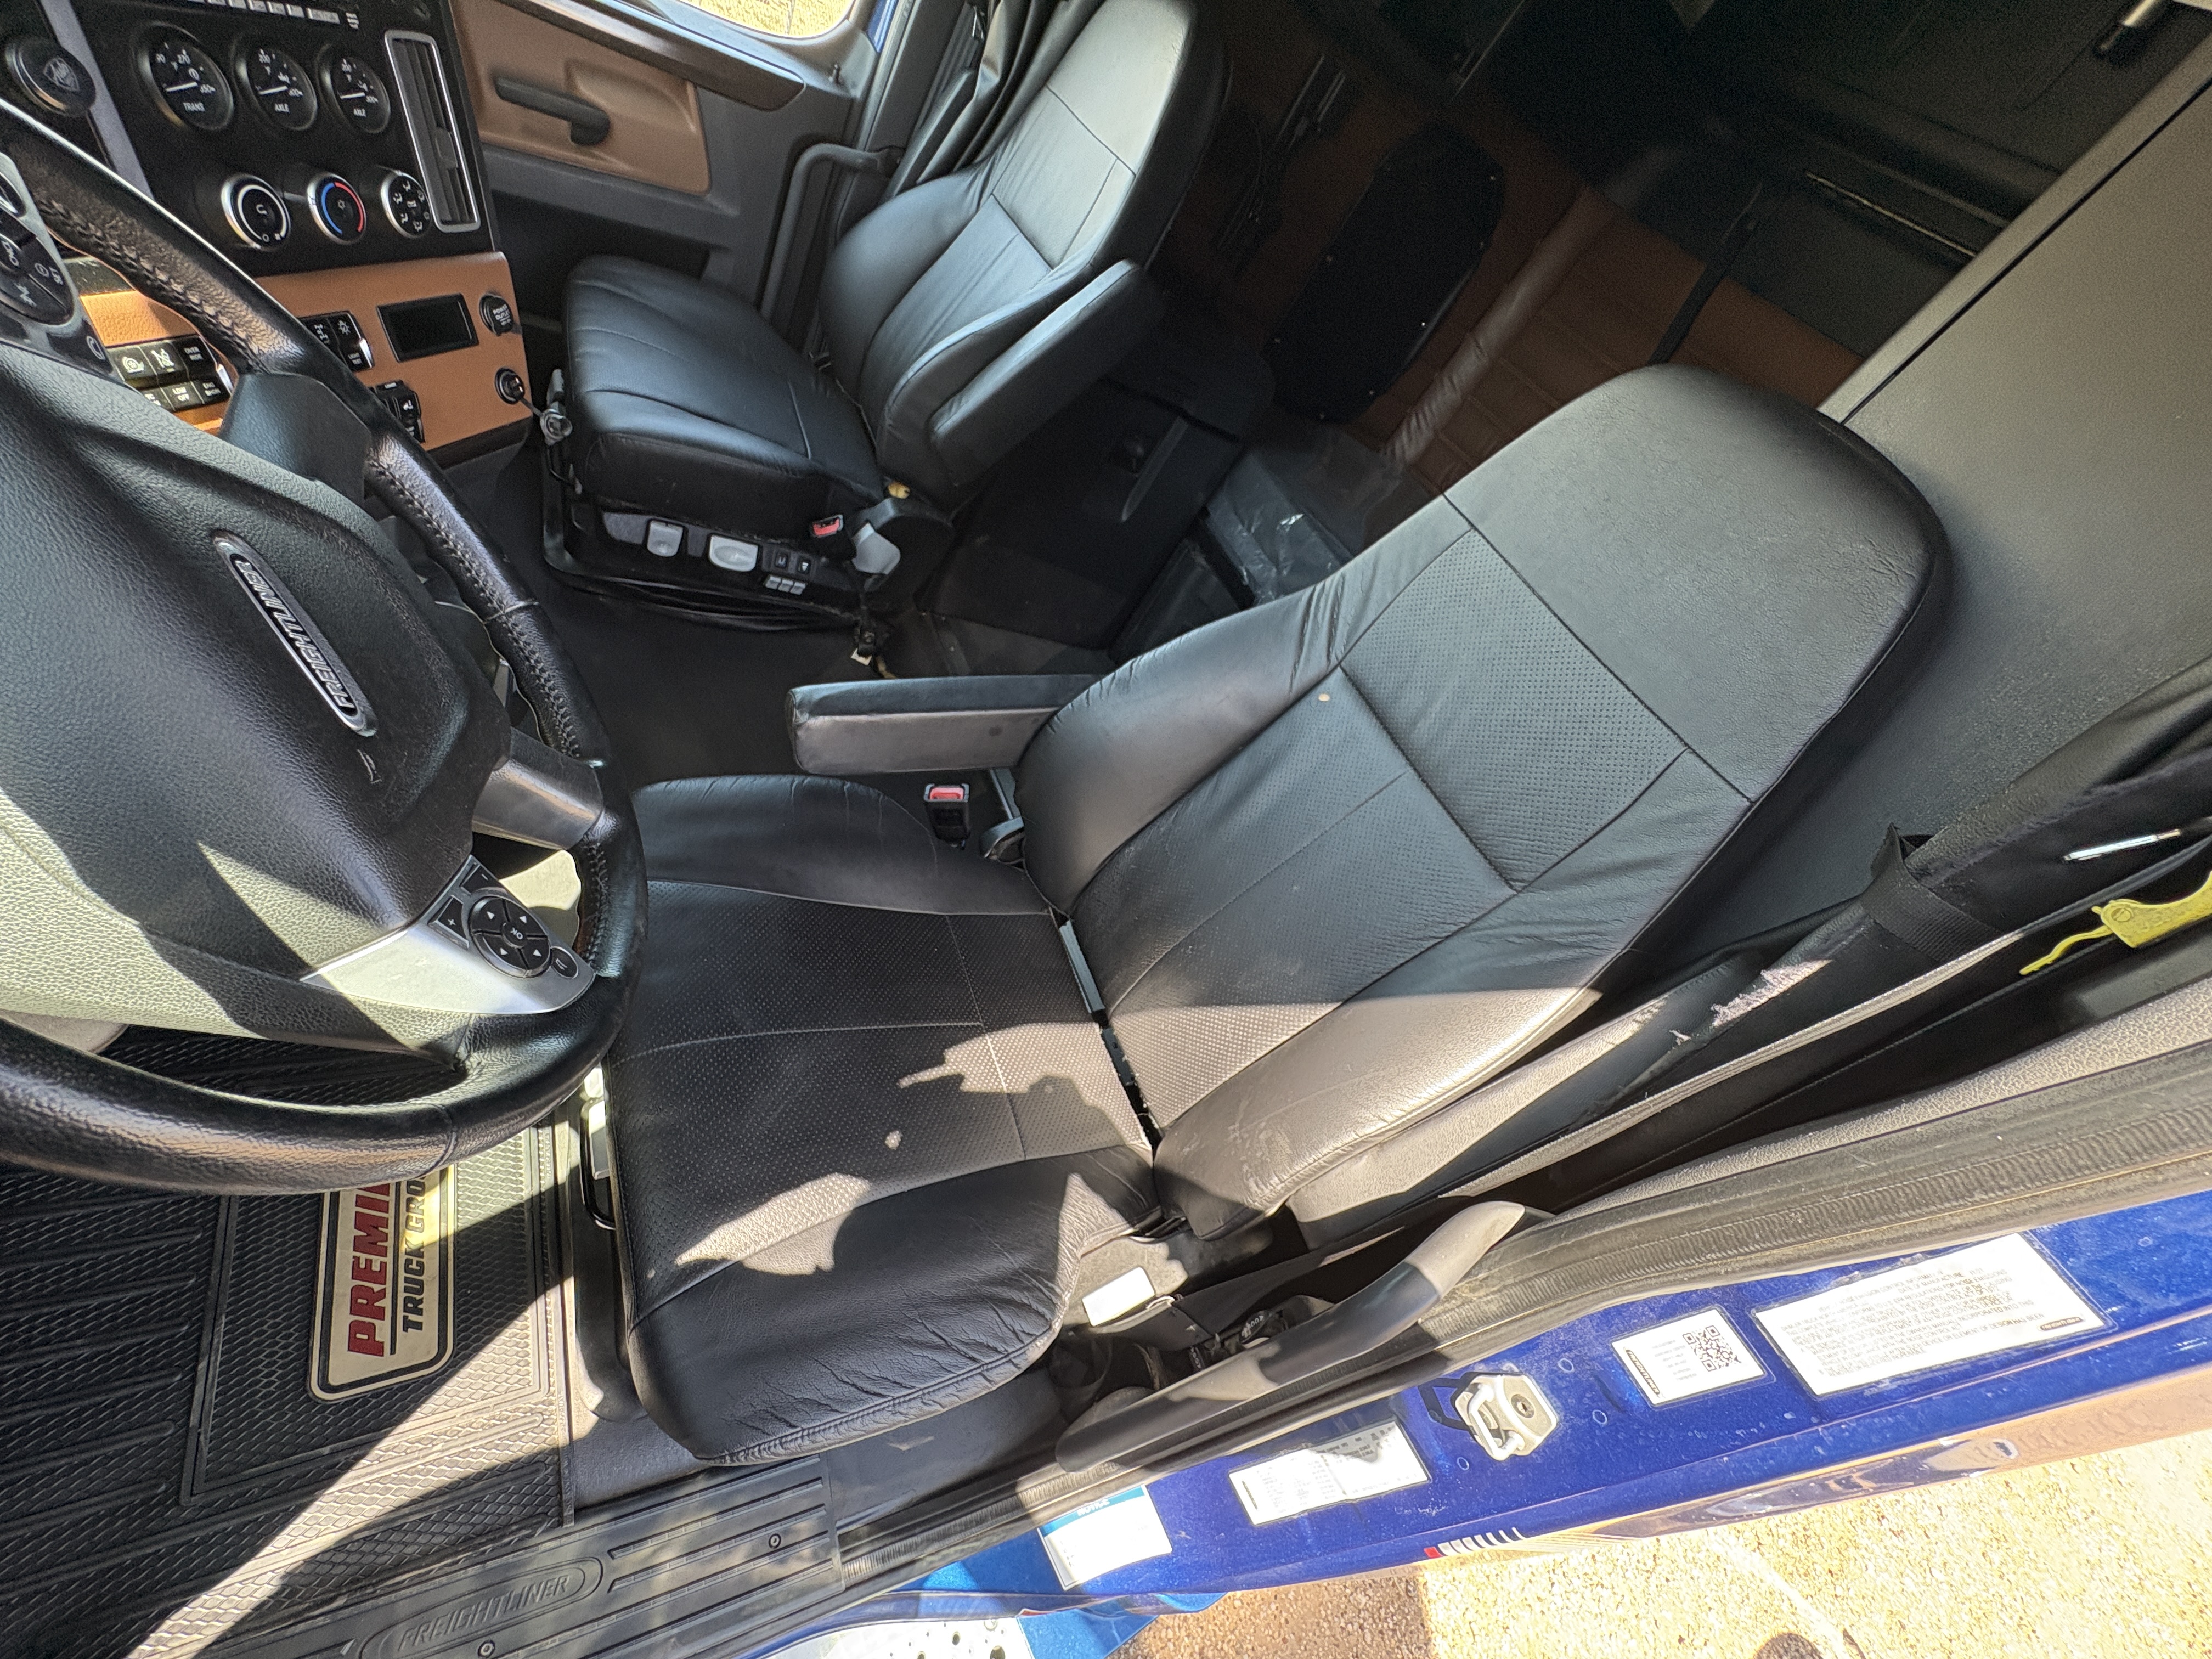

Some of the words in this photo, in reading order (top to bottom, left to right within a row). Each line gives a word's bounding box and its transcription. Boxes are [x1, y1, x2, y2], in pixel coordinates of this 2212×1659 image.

[183, 102, 205, 112] TRANS
[275, 103, 290, 114] AXLE
[354, 108, 366, 117] AXLE
[493, 303, 508, 315] POWER
[184, 346, 201, 354] OVER
[177, 393, 190, 402] OFF
[235, 560, 356, 709] FREIGHTLINER
[510, 927, 524, 940] OK
[405, 1177, 426, 1233] GRO
[348, 1182, 391, 1357] PREMI
[403, 1238, 425, 1333] TRUCK
[1904, 1286, 1943, 1299] REGULATIONS
[1973, 1269, 2007, 1282] EMISSIONS
[1921, 1272, 1964, 1286] MANUFACTURE
[1984, 1276, 2012, 1288] CAUSING
[1880, 1282, 1905, 1291] CONTROL
[1920, 1308, 1940, 1317] OTHER
[1940, 1304, 1957, 1312] THAN
[1969, 1293, 2001, 1305] PURPOSES
[1936, 1293, 1964, 1305] CONTROL
[1953, 1304, 1980, 1314] CONTROL
[1980, 1298, 2003, 1307] DEVICE
[1957, 1307, 2003, 1321] INCORPORATED
[1888, 1346, 1906, 1355] AFTER
[1921, 1337, 1943, 1346] DEVICE
[1952, 1327, 1979, 1339] ELEMENT
[1989, 1320, 2013, 1329] DESIGN
[1923, 1327, 1950, 1338] CONTROL
[397, 1575, 570, 1652] FREIGHTLINER
